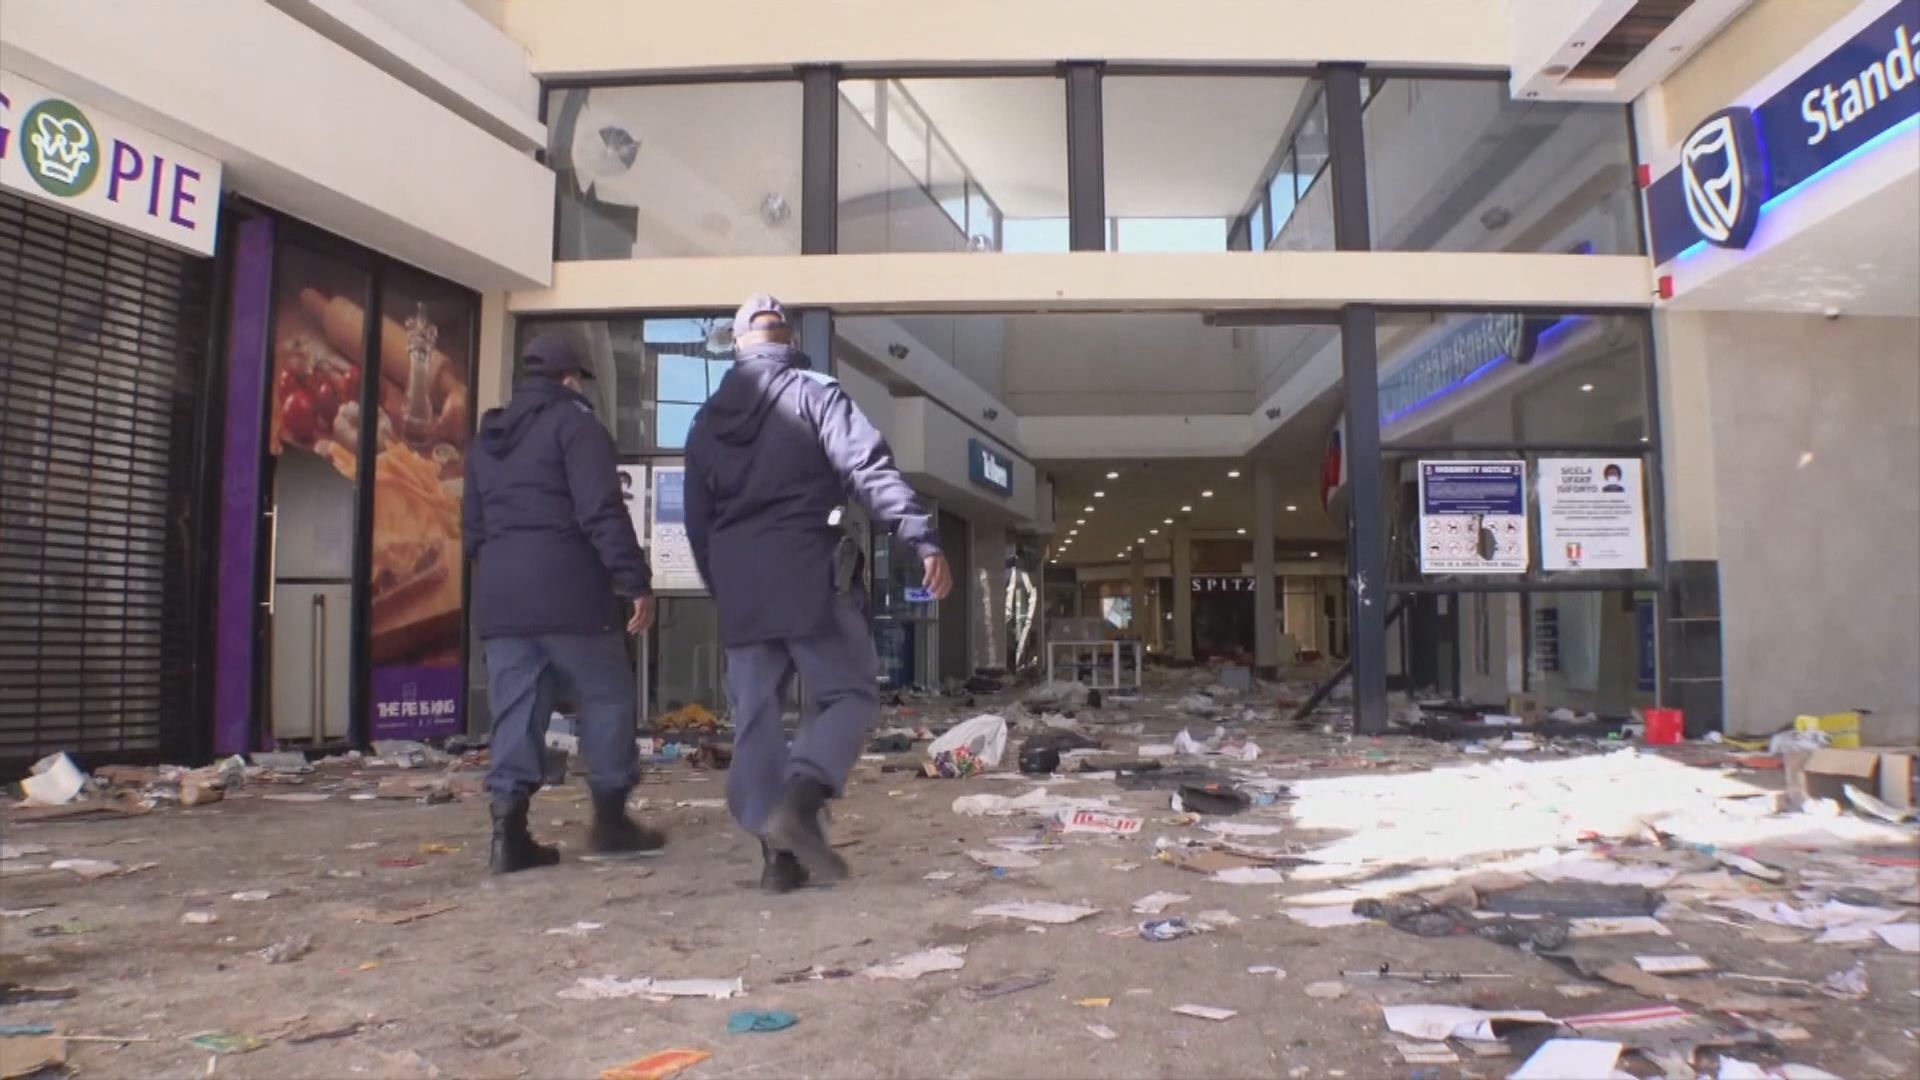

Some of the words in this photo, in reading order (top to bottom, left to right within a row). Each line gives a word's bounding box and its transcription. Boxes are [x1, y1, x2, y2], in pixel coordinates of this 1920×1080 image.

[106, 138, 201, 230] PIE
[1191, 577, 1257, 592] SPITZ
[377, 701, 400, 718] THE
[401, 701, 418, 717] PIE
[419, 701, 430, 716] IS
[431, 699, 455, 715] KING
